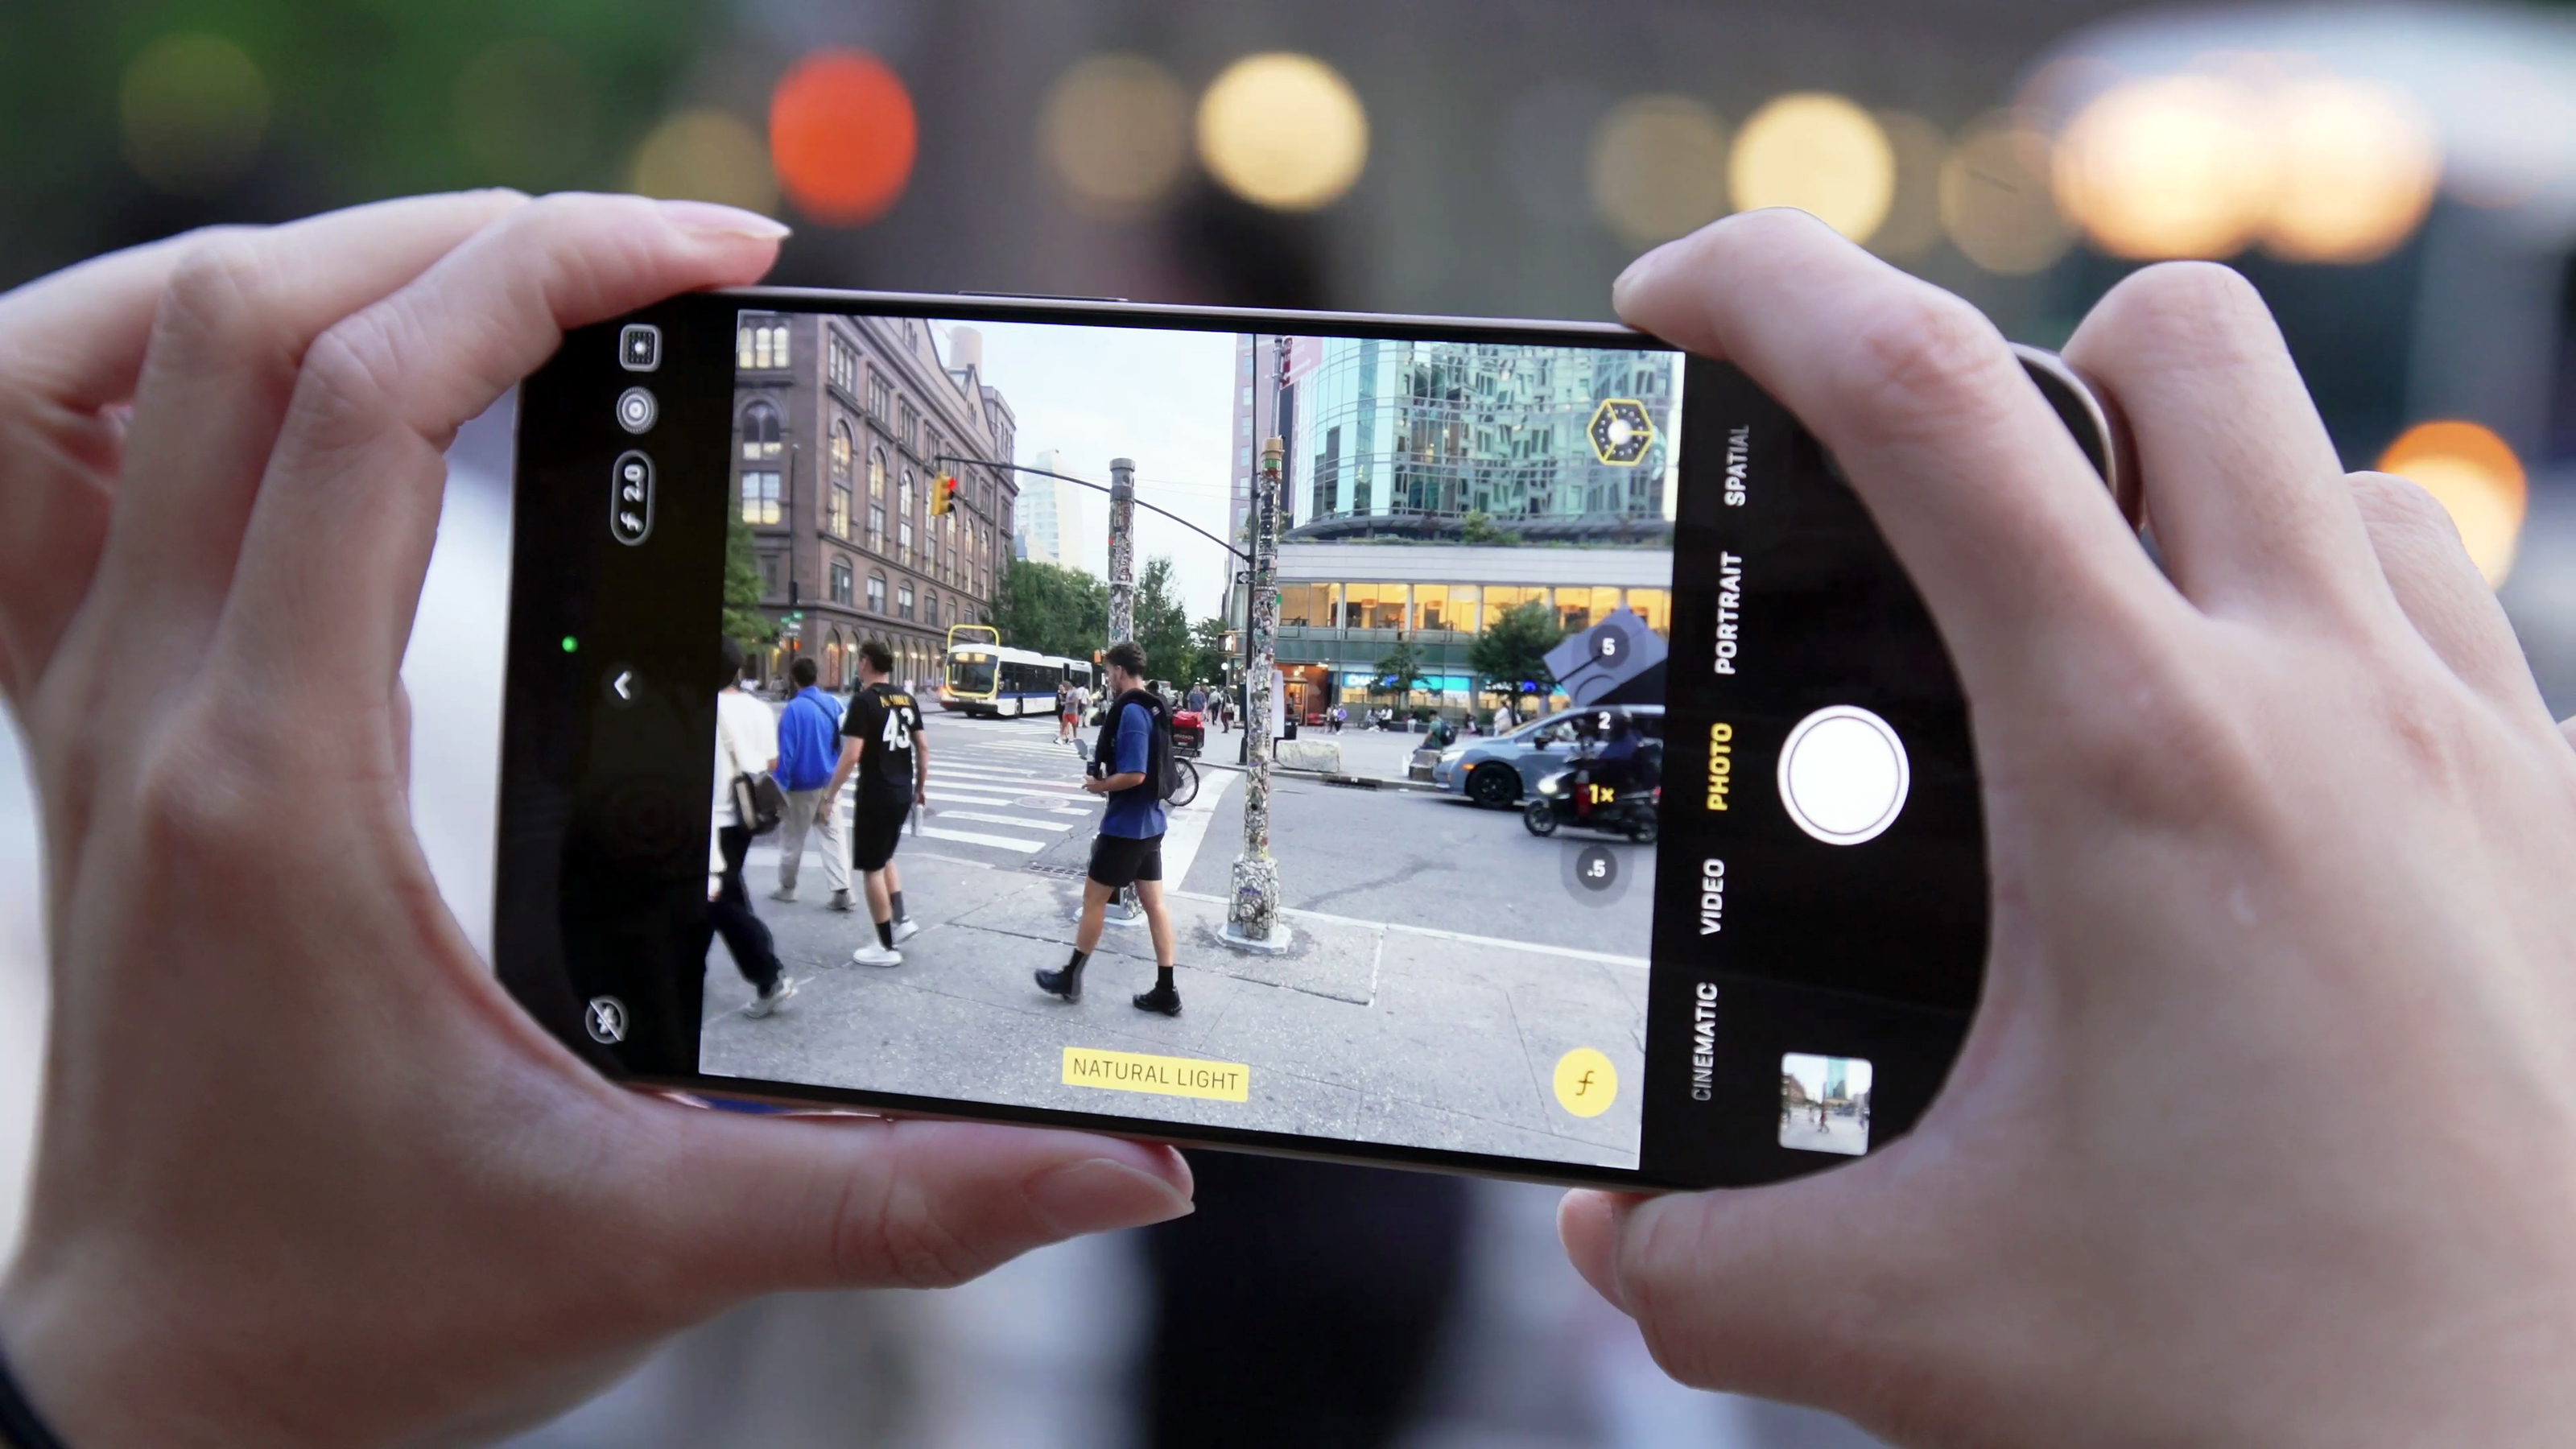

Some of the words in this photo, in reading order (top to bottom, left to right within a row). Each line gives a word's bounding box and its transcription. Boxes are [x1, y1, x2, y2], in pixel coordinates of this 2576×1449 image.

[623, 464, 646, 502] 2.0
[1724, 424, 1749, 507] SPATIAL
[1714, 551, 1742, 675] PORTRAIT
[1602, 638, 1616, 656] 5
[882, 707, 915, 751] 43
[1598, 711, 1612, 730] 2
[1706, 722, 1733, 811] PHOTO
[1588, 784, 1614, 803] 1x
[1587, 859, 1606, 877] .5
[1699, 858, 1725, 935] VIDEO
[1690, 981, 1718, 1101] CINEMATIC
[1073, 1057, 1170, 1085] NATURAL
[1176, 1067, 1239, 1091] LIGHT
